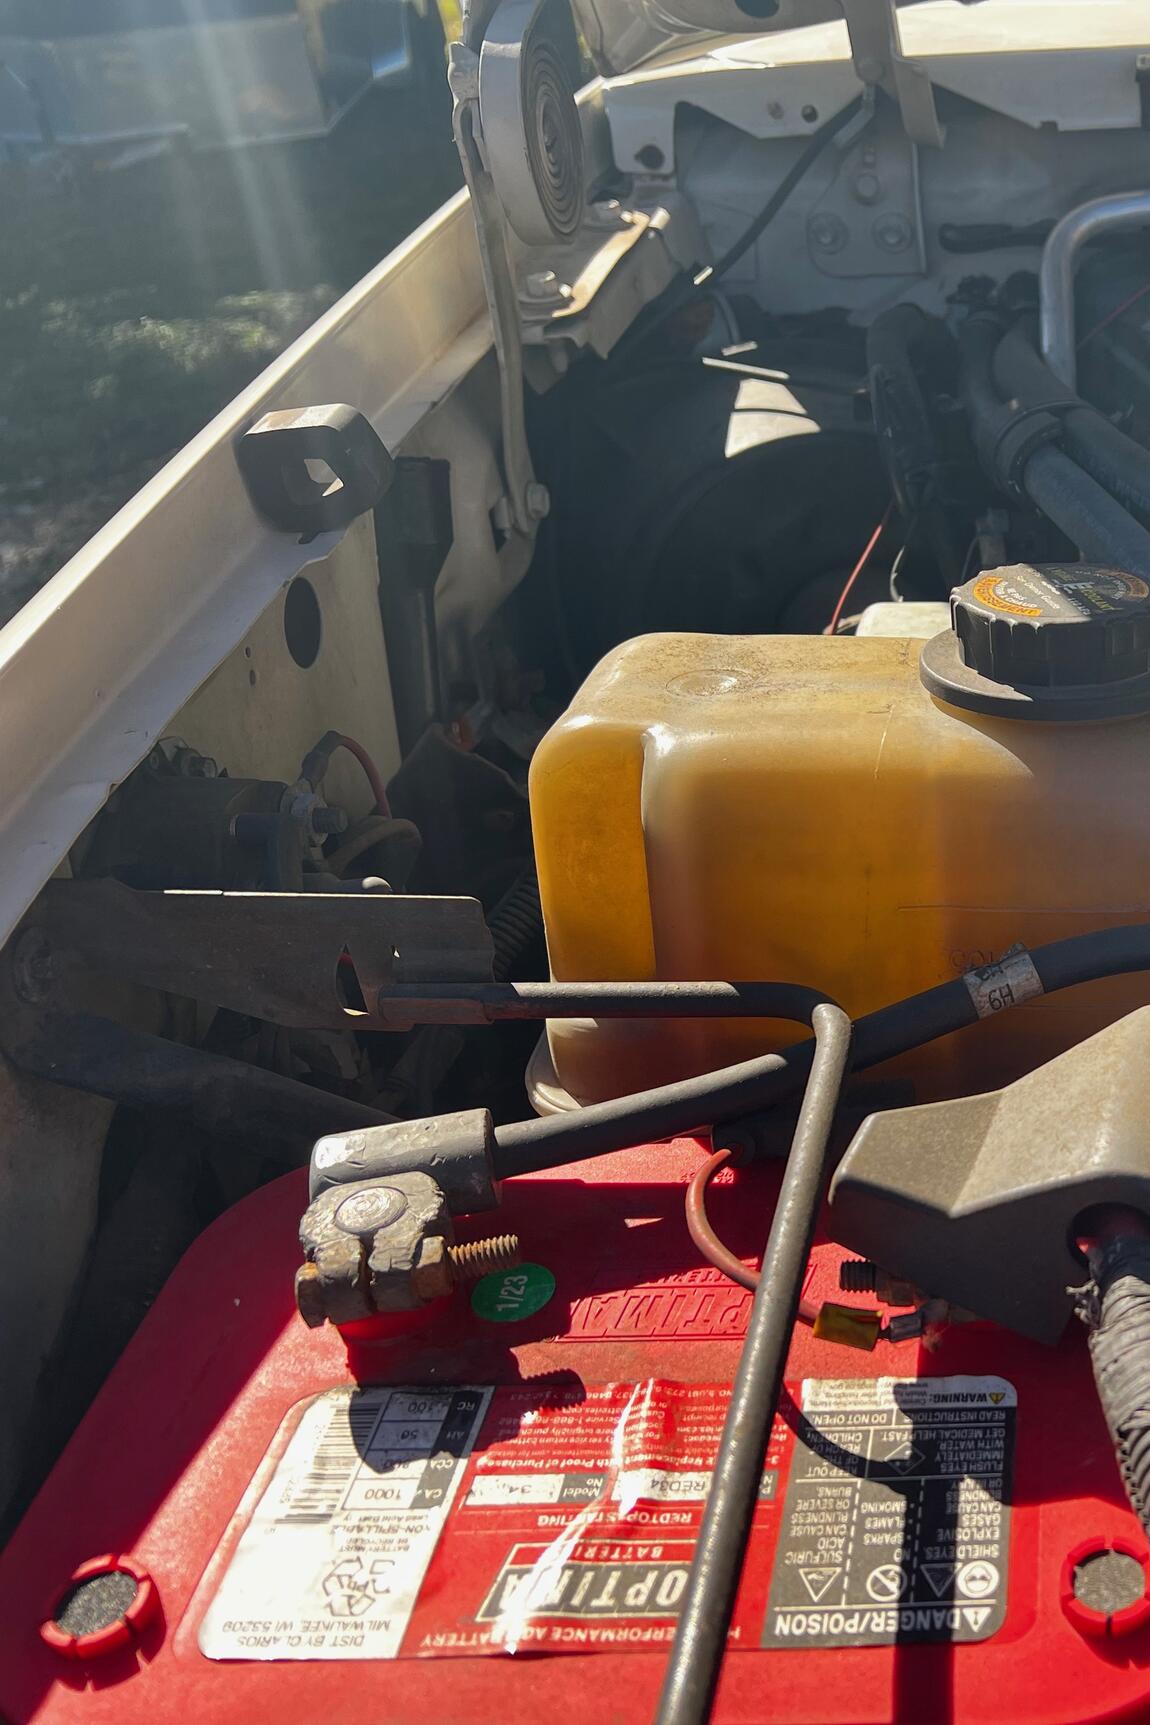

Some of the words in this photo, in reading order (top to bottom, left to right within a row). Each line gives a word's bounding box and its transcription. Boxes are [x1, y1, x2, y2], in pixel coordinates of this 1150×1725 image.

[495, 1273, 529, 1314] 1/23
[582, 1293, 753, 1331] PTIMA
[928, 1392, 987, 1403] WARNING:
[456, 1401, 476, 1411] RC
[846, 1413, 869, 1425] NOT
[869, 1412, 887, 1424] DO
[978, 1410, 1005, 1421] READ
[939, 1429, 984, 1440] MEDICAL
[985, 1428, 1005, 1439] GET
[977, 1439, 1004, 1450] WITH
[934, 1450, 1004, 1463] IMMEDIATELY
[429, 1458, 454, 1469] CCA
[546, 1458, 559, 1468] of
[562, 1458, 594, 1468] Proof
[940, 1461, 968, 1473] EYES
[969, 1460, 1004, 1472] FLUSH
[805, 1466, 828, 1478] OUT
[586, 1478, 603, 1487] No
[364, 1488, 401, 1501] 1000
[424, 1488, 443, 1499] CA
[562, 1487, 600, 1498] Model
[796, 1499, 833, 1511] SEVERE
[834, 1498, 850, 1509] OR
[860, 1501, 905, 1514] SMOKING
[980, 1501, 1001, 1514] CAN
[791, 1511, 848, 1524] BLINDNESS
[961, 1514, 1000, 1527] GASES
[789, 1525, 824, 1537] CAUSE
[825, 1524, 847, 1535] CAN
[936, 1527, 1000, 1542] EXPLOSIVE
[817, 1536, 845, 1550] ACID
[863, 1532, 903, 1545] SPARKS
[560, 1545, 664, 1560] BATTERI
[784, 1550, 843, 1565] SULFURIC
[956, 1544, 999, 1559] SHIELD
[274, 1620, 294, 1632] WI
[301, 1619, 391, 1633] MILWAUKEE
[775, 1609, 959, 1635] DANGER/POISON
[551, 1626, 676, 1641] ERFORMANCE
[304, 1635, 326, 1648] BY
[330, 1635, 365, 1648] DIST
